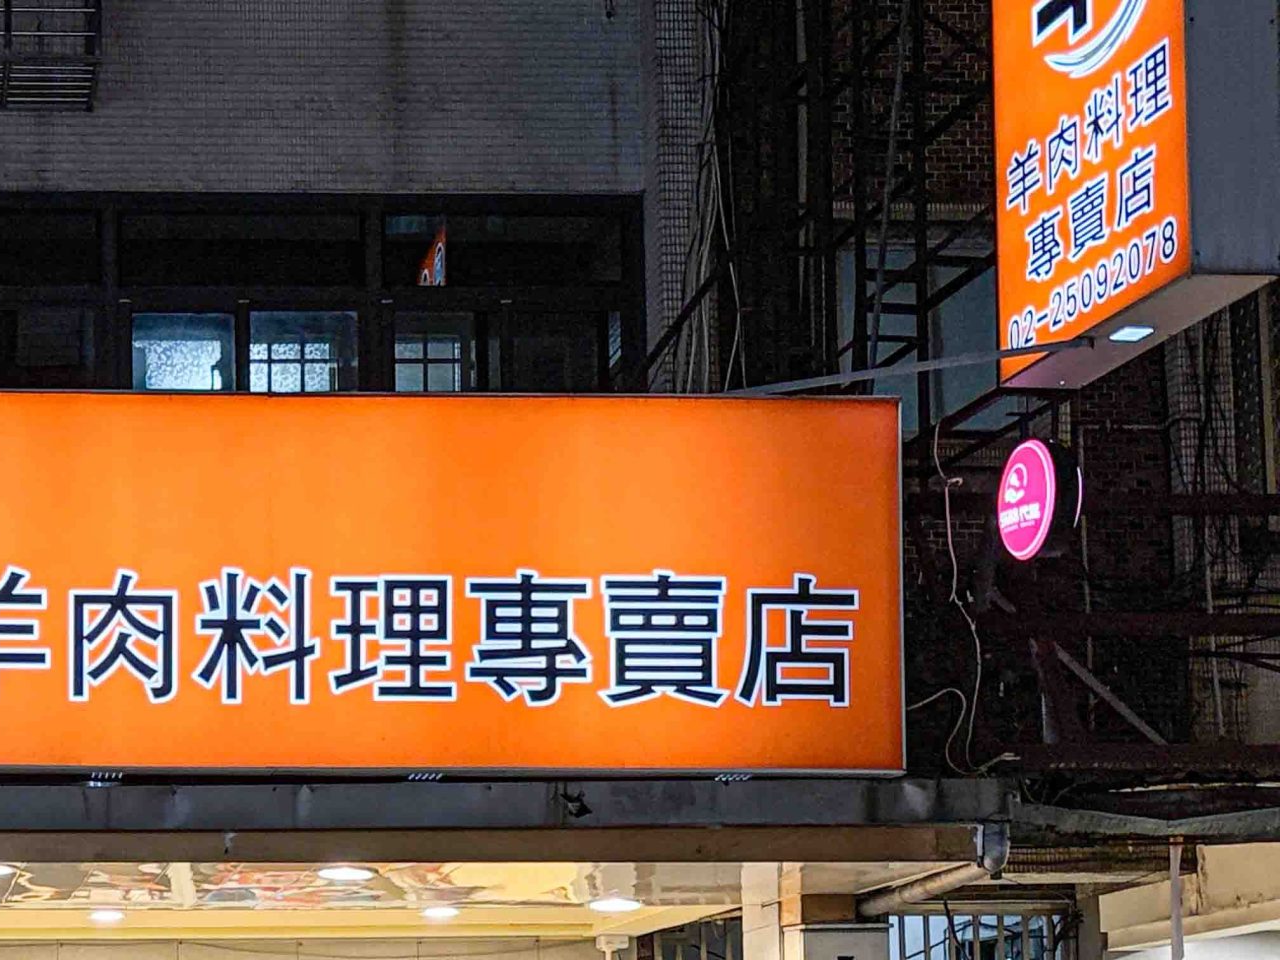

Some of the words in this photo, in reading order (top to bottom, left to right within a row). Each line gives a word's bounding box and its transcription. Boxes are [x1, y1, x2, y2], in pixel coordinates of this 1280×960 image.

[1006, 38, 1172, 211] 羊肉料理
[1026, 147, 1156, 280] 專賣店
[1008, 219, 1177, 350] 02-25092078
